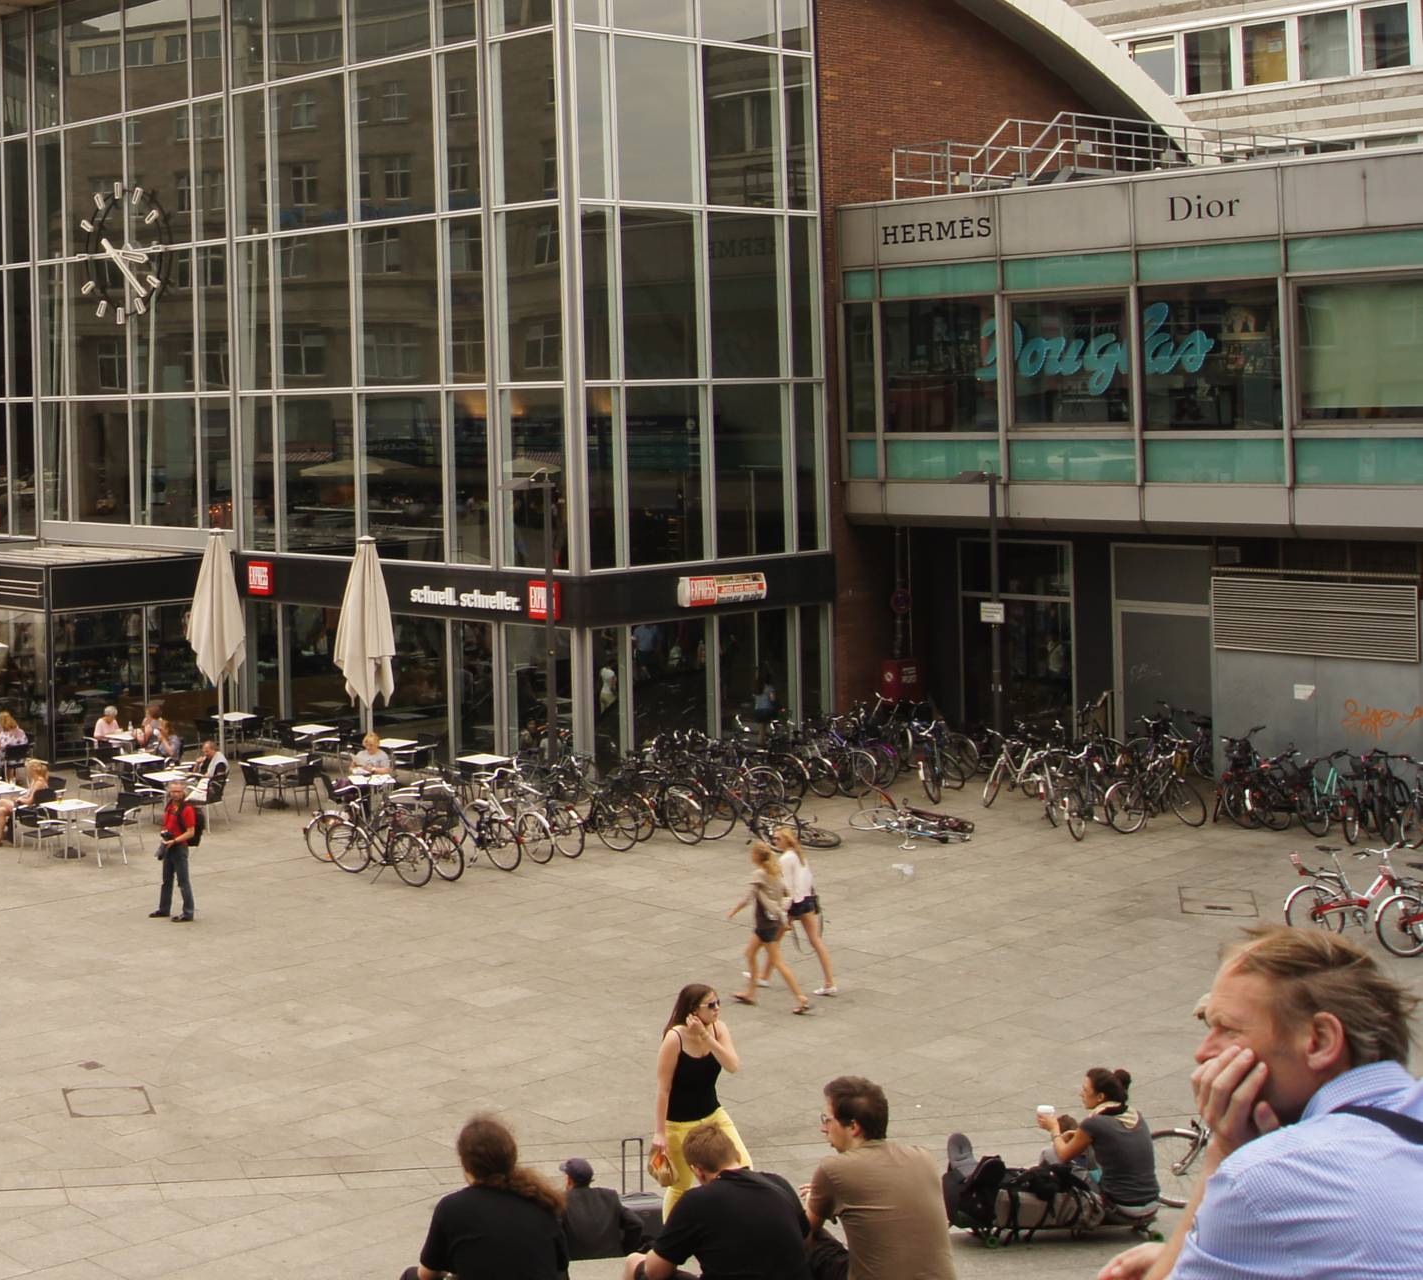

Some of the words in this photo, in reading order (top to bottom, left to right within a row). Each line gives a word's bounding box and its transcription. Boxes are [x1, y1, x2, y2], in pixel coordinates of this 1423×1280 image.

[1166, 194, 1240, 222] Dior
[977, 302, 1215, 396] Douglas
[410, 585, 458, 606] schnell.
[459, 589, 521, 612] schneller.
